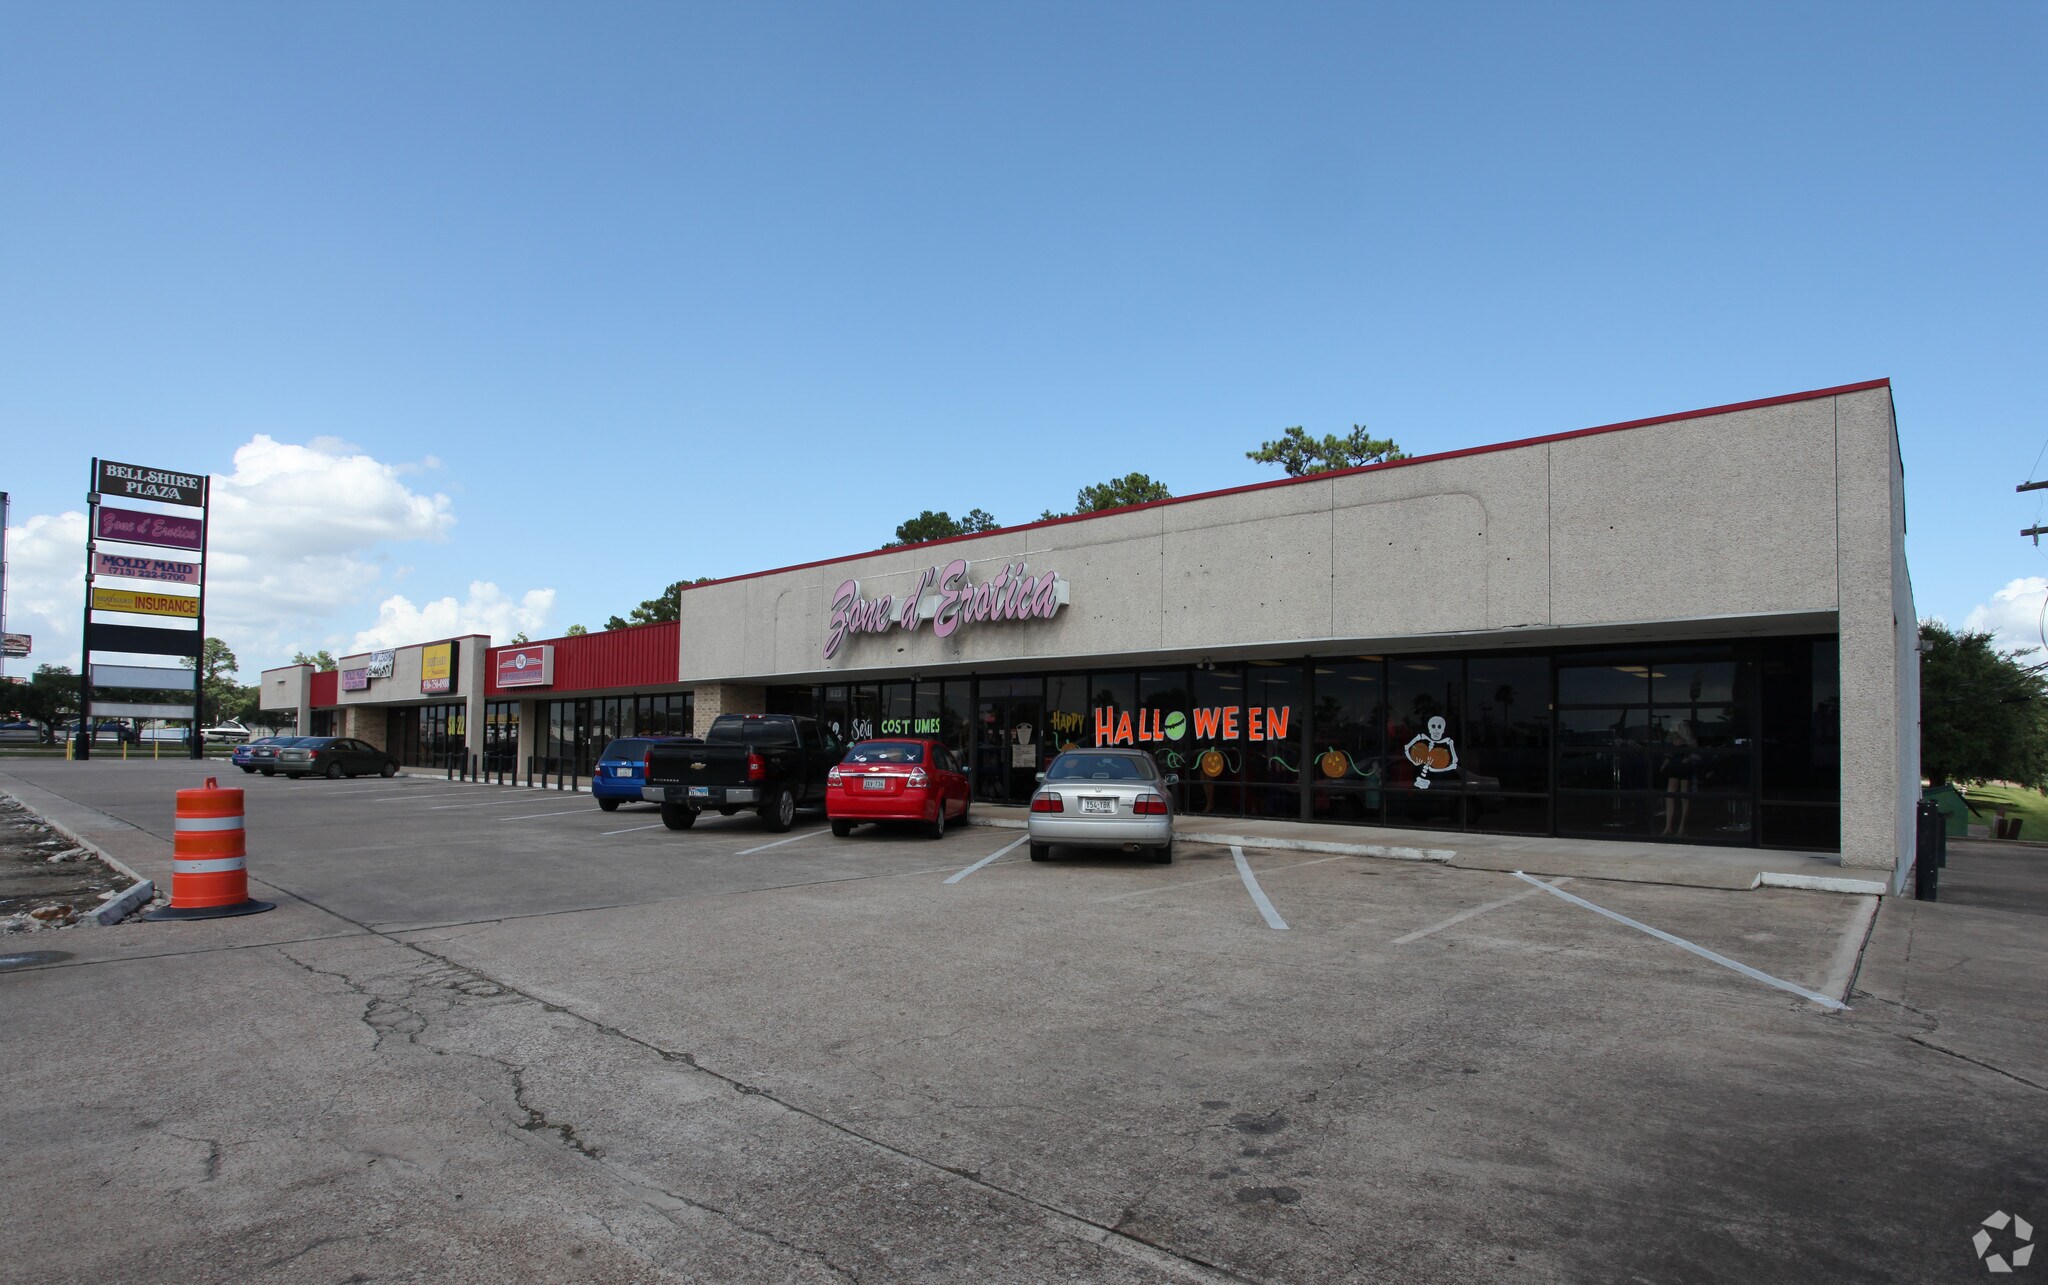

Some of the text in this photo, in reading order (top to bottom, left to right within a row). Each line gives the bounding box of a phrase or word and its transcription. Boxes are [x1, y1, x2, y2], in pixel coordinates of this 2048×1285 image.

[106, 464, 198, 489] BELLSHIRE
[126, 481, 182, 500] PLAZA
[103, 513, 135, 534] Zone
[102, 555, 193, 574] MOLLY MAID
[109, 566, 186, 582] (713) 222-6700
[135, 596, 196, 613] INSURANCE
[823, 579, 894, 659] Zone
[1050, 710, 1084, 734] HAPPY
